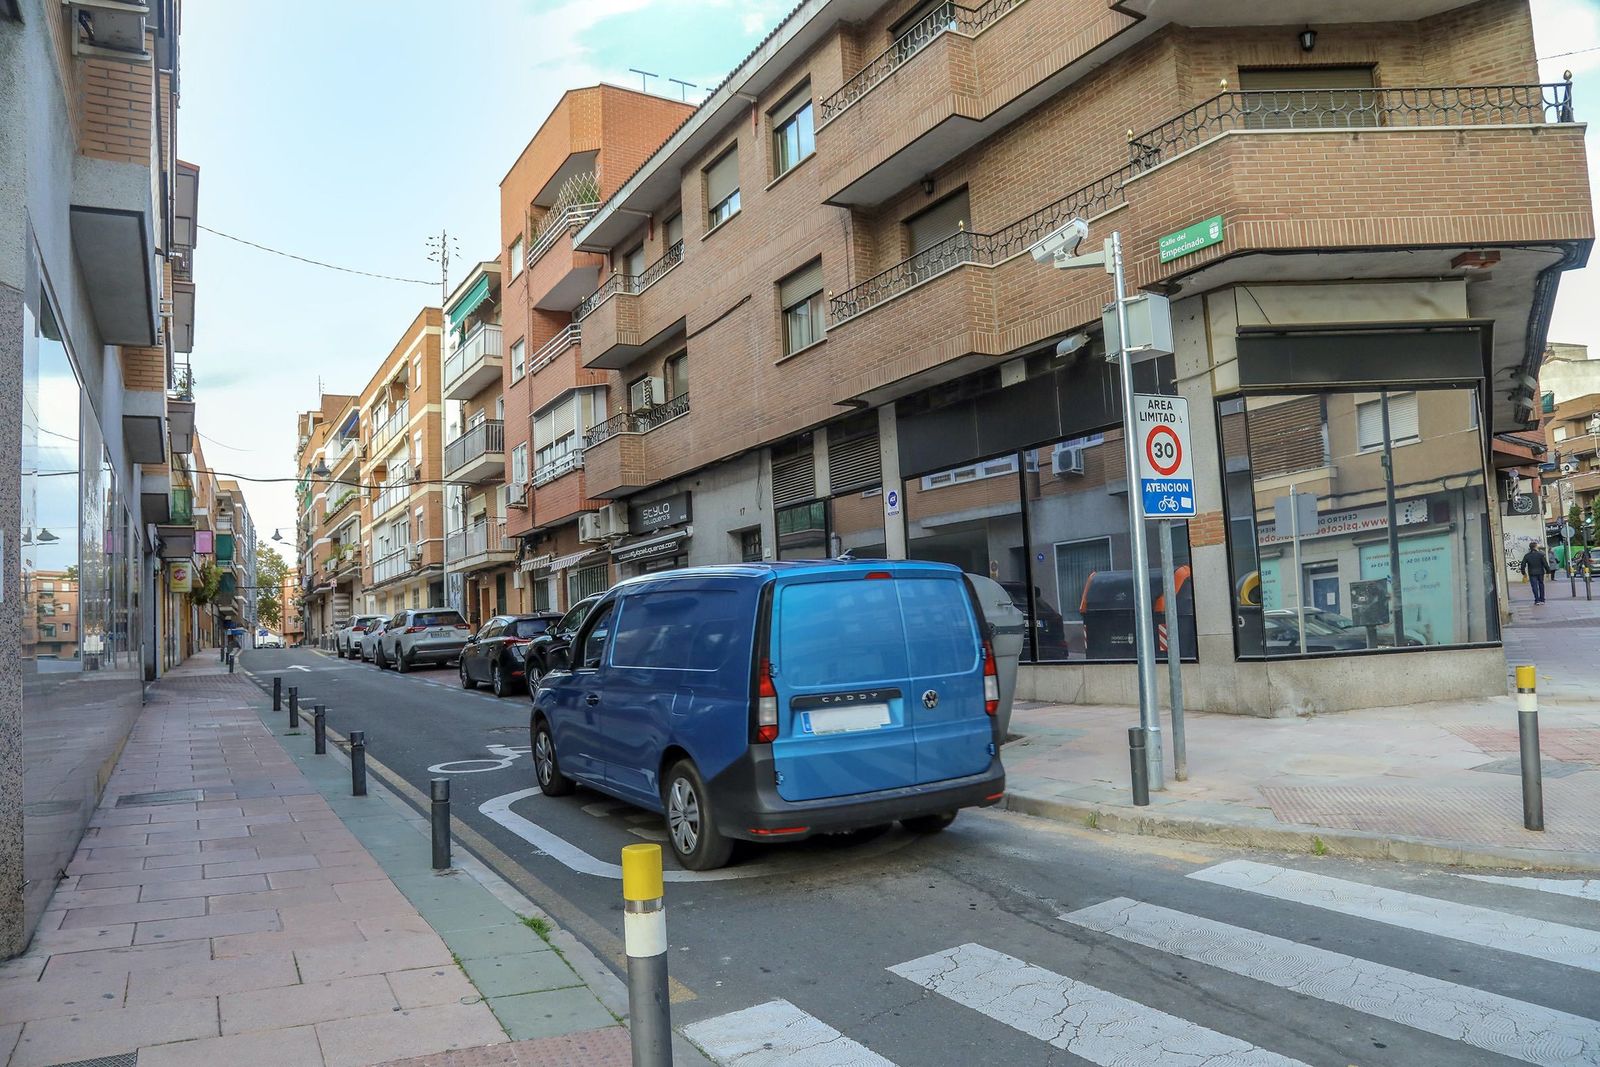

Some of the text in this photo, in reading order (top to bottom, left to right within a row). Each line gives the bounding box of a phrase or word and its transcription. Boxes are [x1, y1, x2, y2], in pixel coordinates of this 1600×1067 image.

[1160, 232, 1186, 248] Calle del
[1161, 236, 1204, 259] Empecinado
[1147, 399, 1174, 410] AREA
[1139, 411, 1183, 423] LIMITAD
[1153, 442, 1174, 459] 30
[1145, 482, 1189, 492] ATENCION
[821, 692, 878, 703] CADDY
